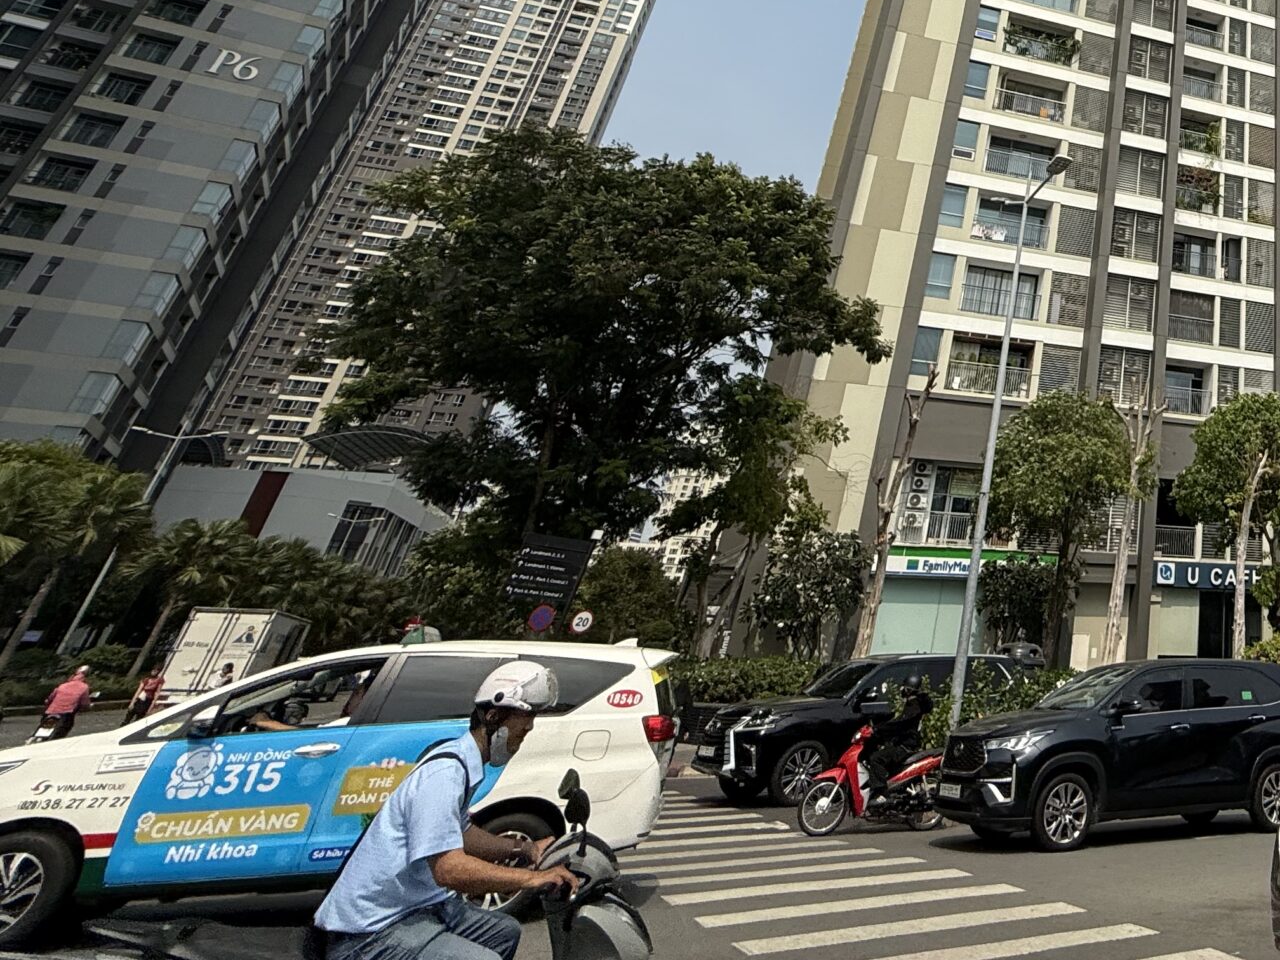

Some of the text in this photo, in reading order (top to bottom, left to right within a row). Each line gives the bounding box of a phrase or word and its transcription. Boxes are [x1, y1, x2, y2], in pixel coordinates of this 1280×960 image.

[205, 48, 261, 80] P6
[923, 560, 971, 572] FamilyMar
[1187, 567, 1199, 584] U
[575, 617, 589, 627] 20
[609, 693, 641, 705] 18540
[214, 761, 286, 795] 315
[57, 783, 107, 792] VINASUN
[340, 791, 378, 805] TOÀN
[239, 809, 300, 832] VÀNG
[164, 842, 259, 864] Nhi khoa
